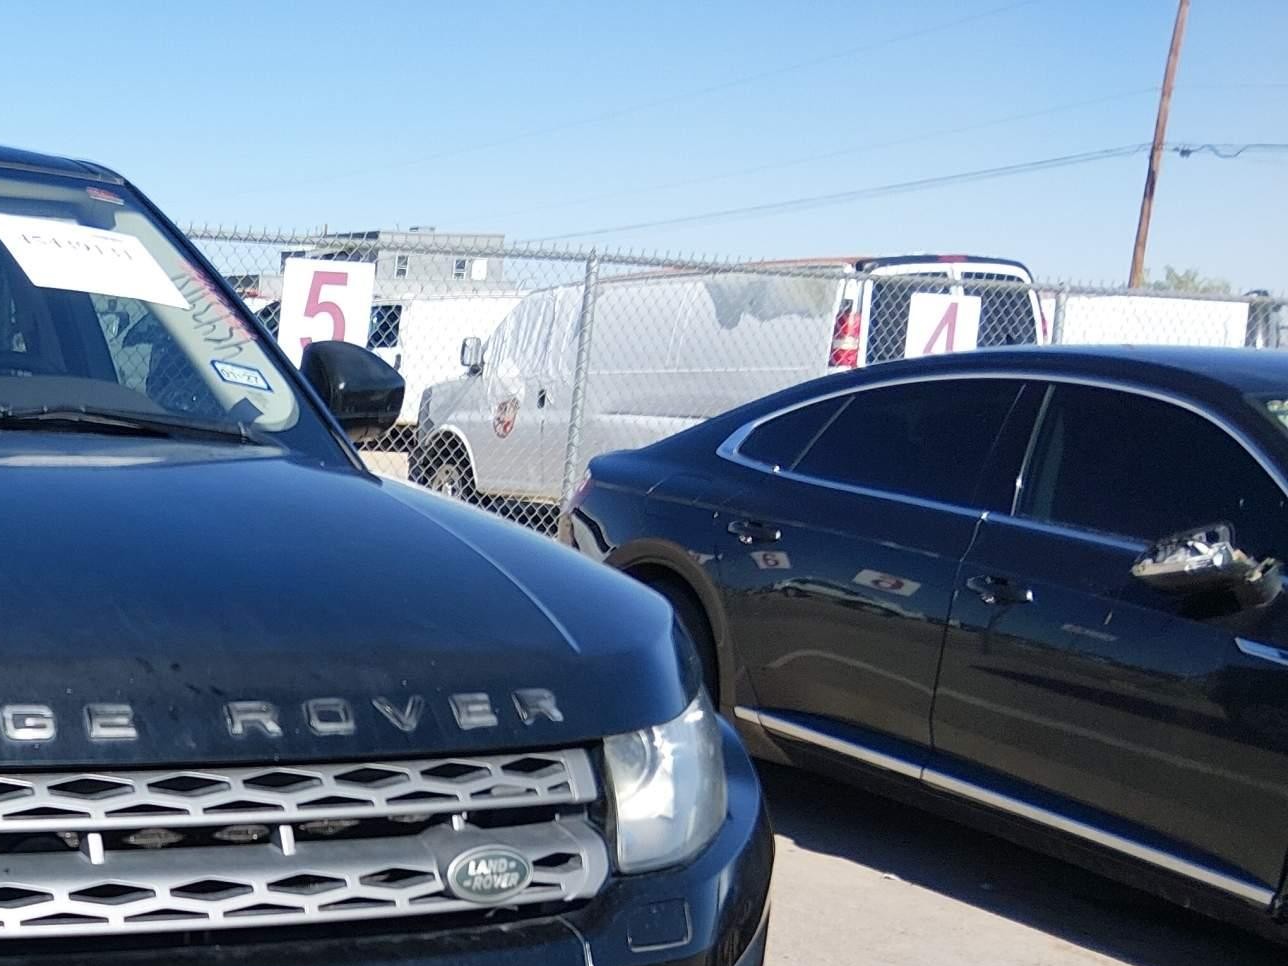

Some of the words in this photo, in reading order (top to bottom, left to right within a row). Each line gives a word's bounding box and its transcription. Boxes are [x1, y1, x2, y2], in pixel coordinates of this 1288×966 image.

[300, 271, 346, 350] 5
[223, 688, 565, 737] ROVER
[468, 858, 508, 876] LAND
[472, 872, 520, 891] ROVER
